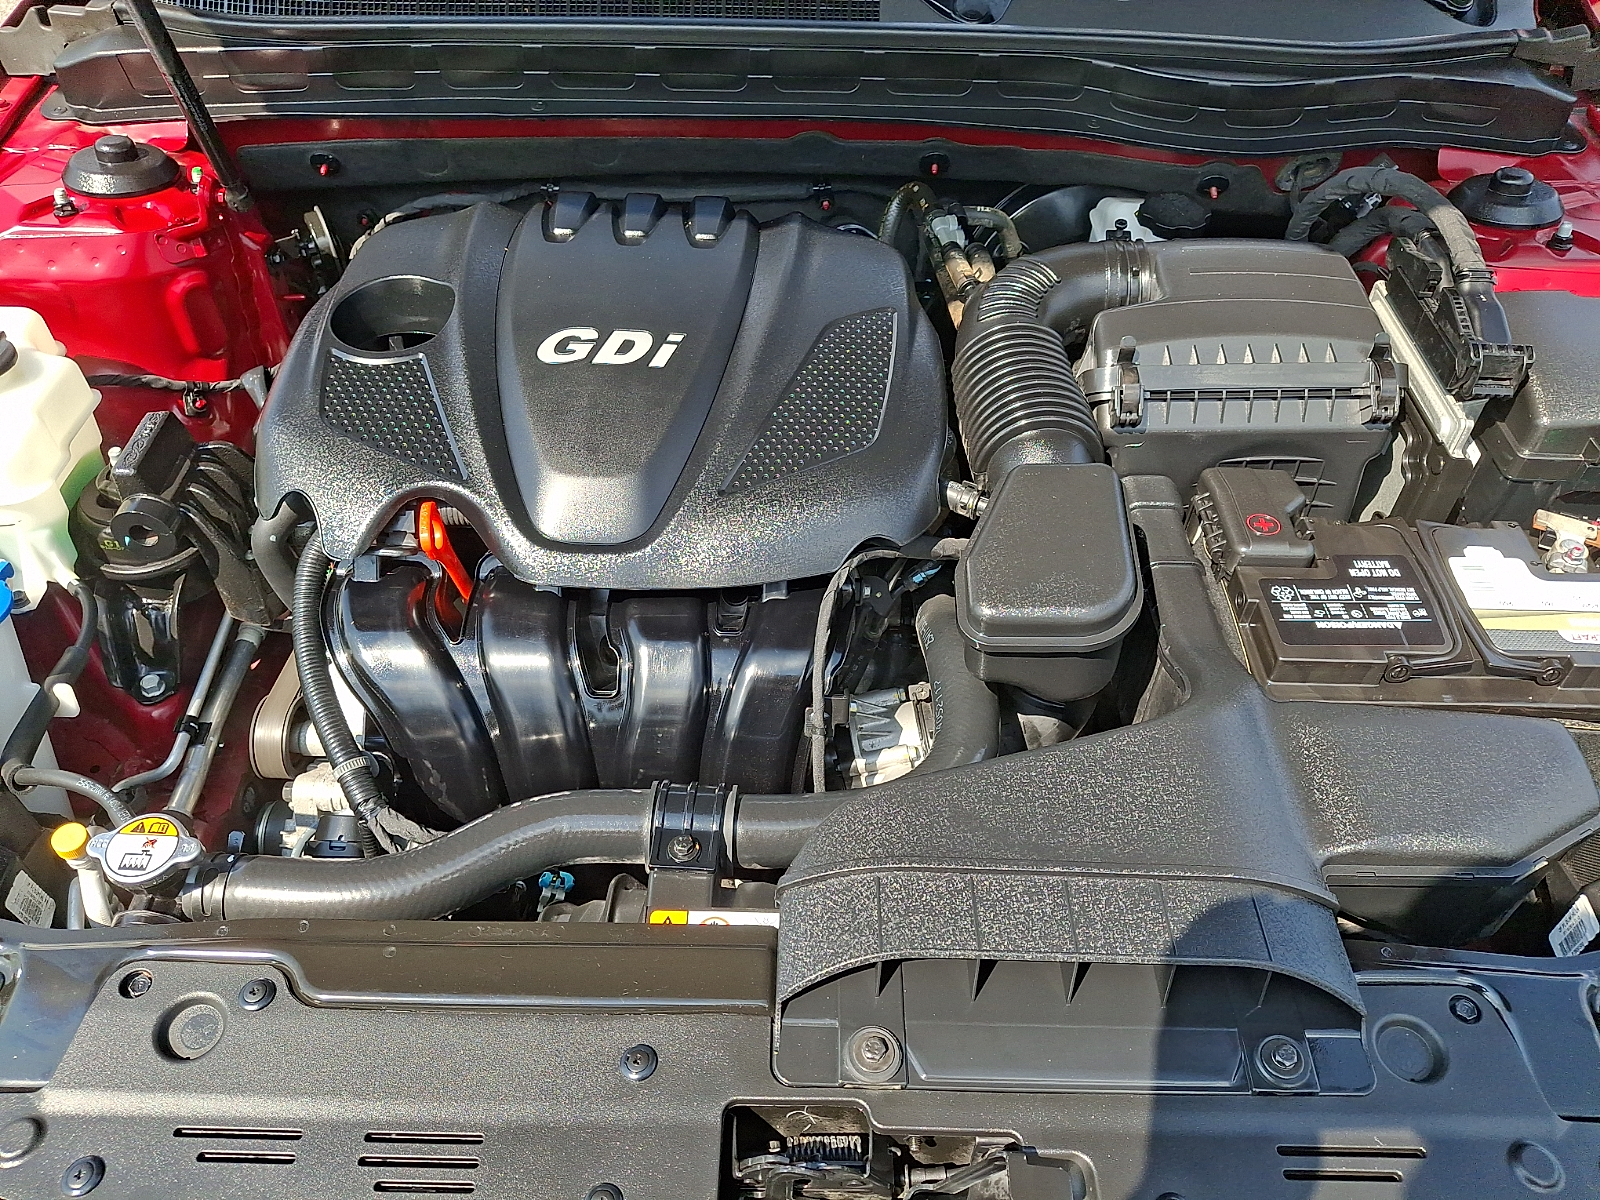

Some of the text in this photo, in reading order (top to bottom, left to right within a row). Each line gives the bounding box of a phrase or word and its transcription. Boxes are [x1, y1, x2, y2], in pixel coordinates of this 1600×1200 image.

[536, 326, 687, 368] GDi
[1348, 568, 1371, 577] OPEN
[1371, 569, 1388, 577] NOT
